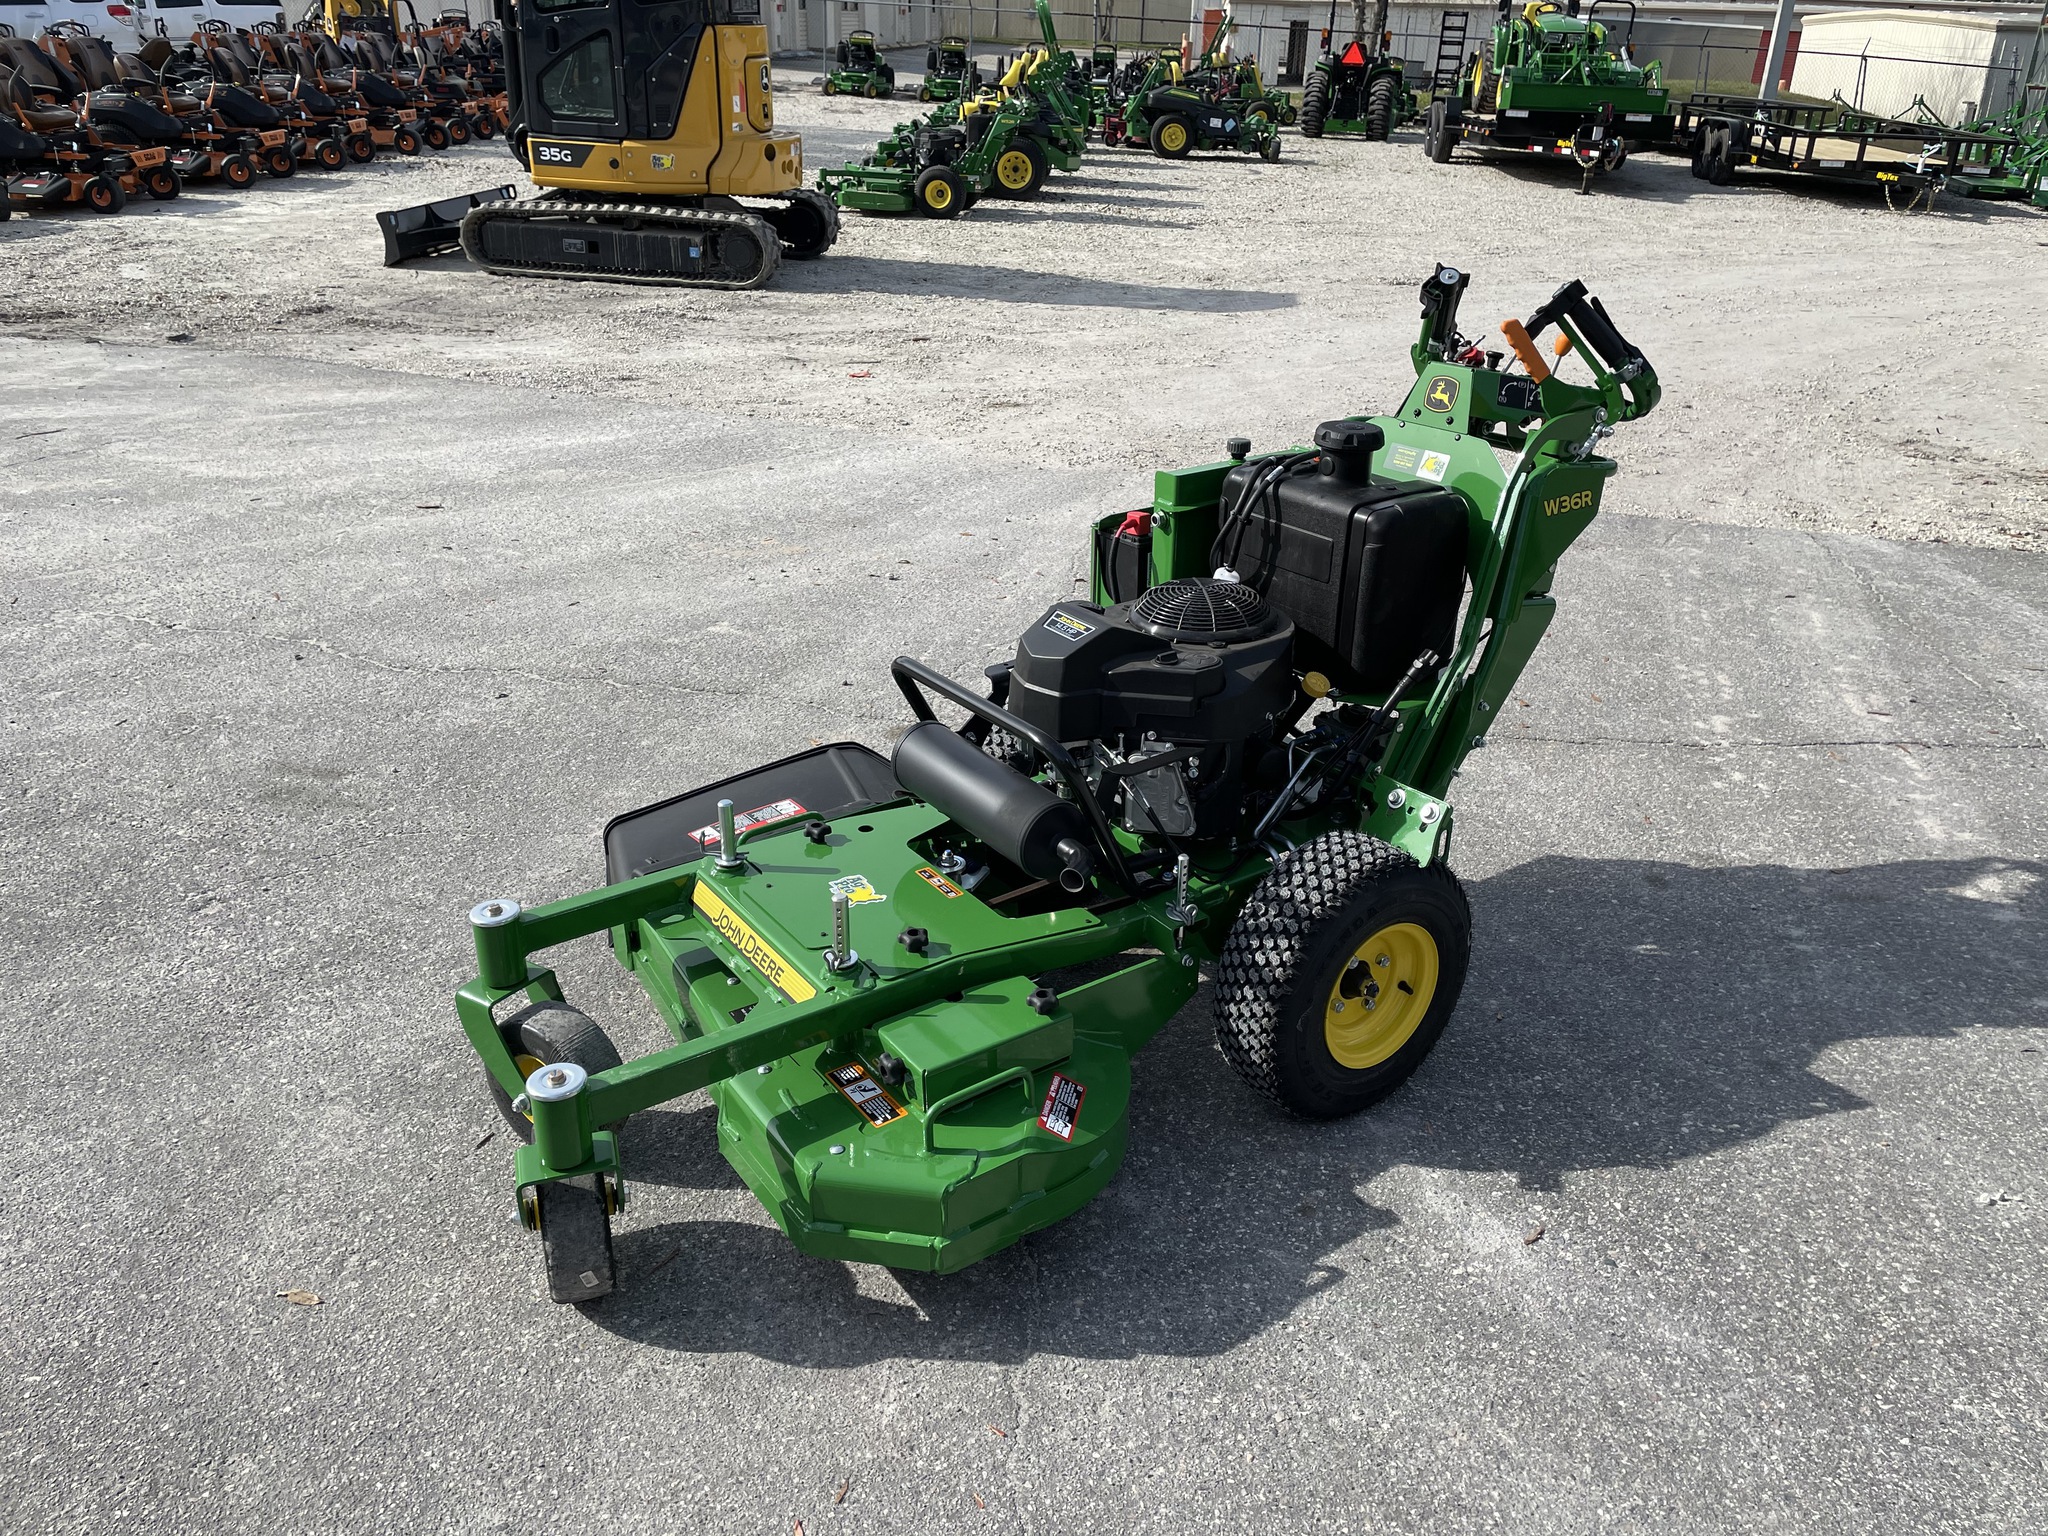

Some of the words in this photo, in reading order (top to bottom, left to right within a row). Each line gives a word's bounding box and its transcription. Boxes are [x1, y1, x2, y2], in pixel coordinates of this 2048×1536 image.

[539, 147, 572, 162] 35G
[1543, 490, 1593, 517] W36R
[1066, 626, 1078, 634] HP
[834, 880, 855, 893] Pro
[713, 908, 745, 945] JOHN
[743, 935, 785, 984] DEERE
